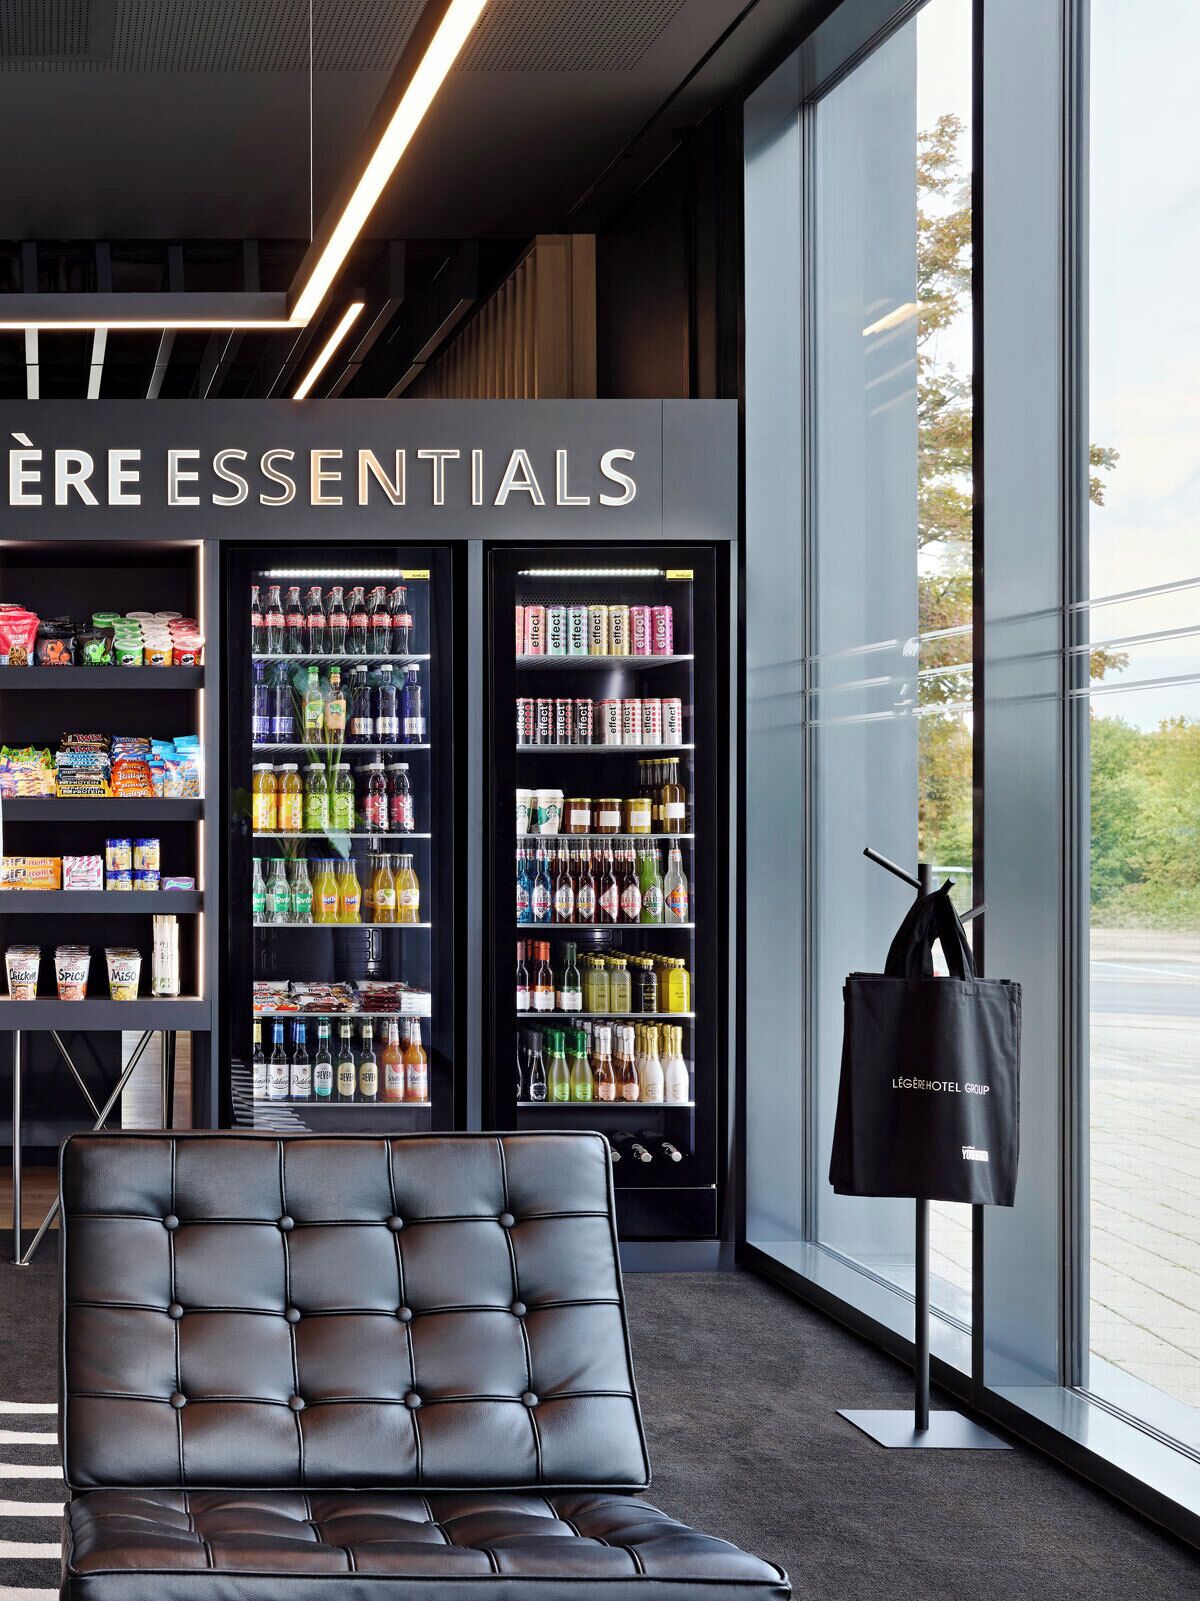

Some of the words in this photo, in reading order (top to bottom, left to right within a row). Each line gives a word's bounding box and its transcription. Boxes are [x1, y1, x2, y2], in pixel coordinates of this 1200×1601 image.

[166, 447, 639, 509] ESSENTIALS
[530, 614, 540, 648] effect
[551, 614, 561, 648] effect
[572, 614, 582, 648] effect
[636, 613, 645, 648] effect
[657, 613, 666, 648] effect
[539, 705, 548, 736] effect
[557, 705, 565, 736] effect
[579, 705, 587, 736] effect
[608, 706, 616, 734] effect
[892, 1076, 926, 1089] LÉGÈRE
[926, 1081, 961, 1092] HOTEL
[964, 1082, 990, 1095] GROUP
